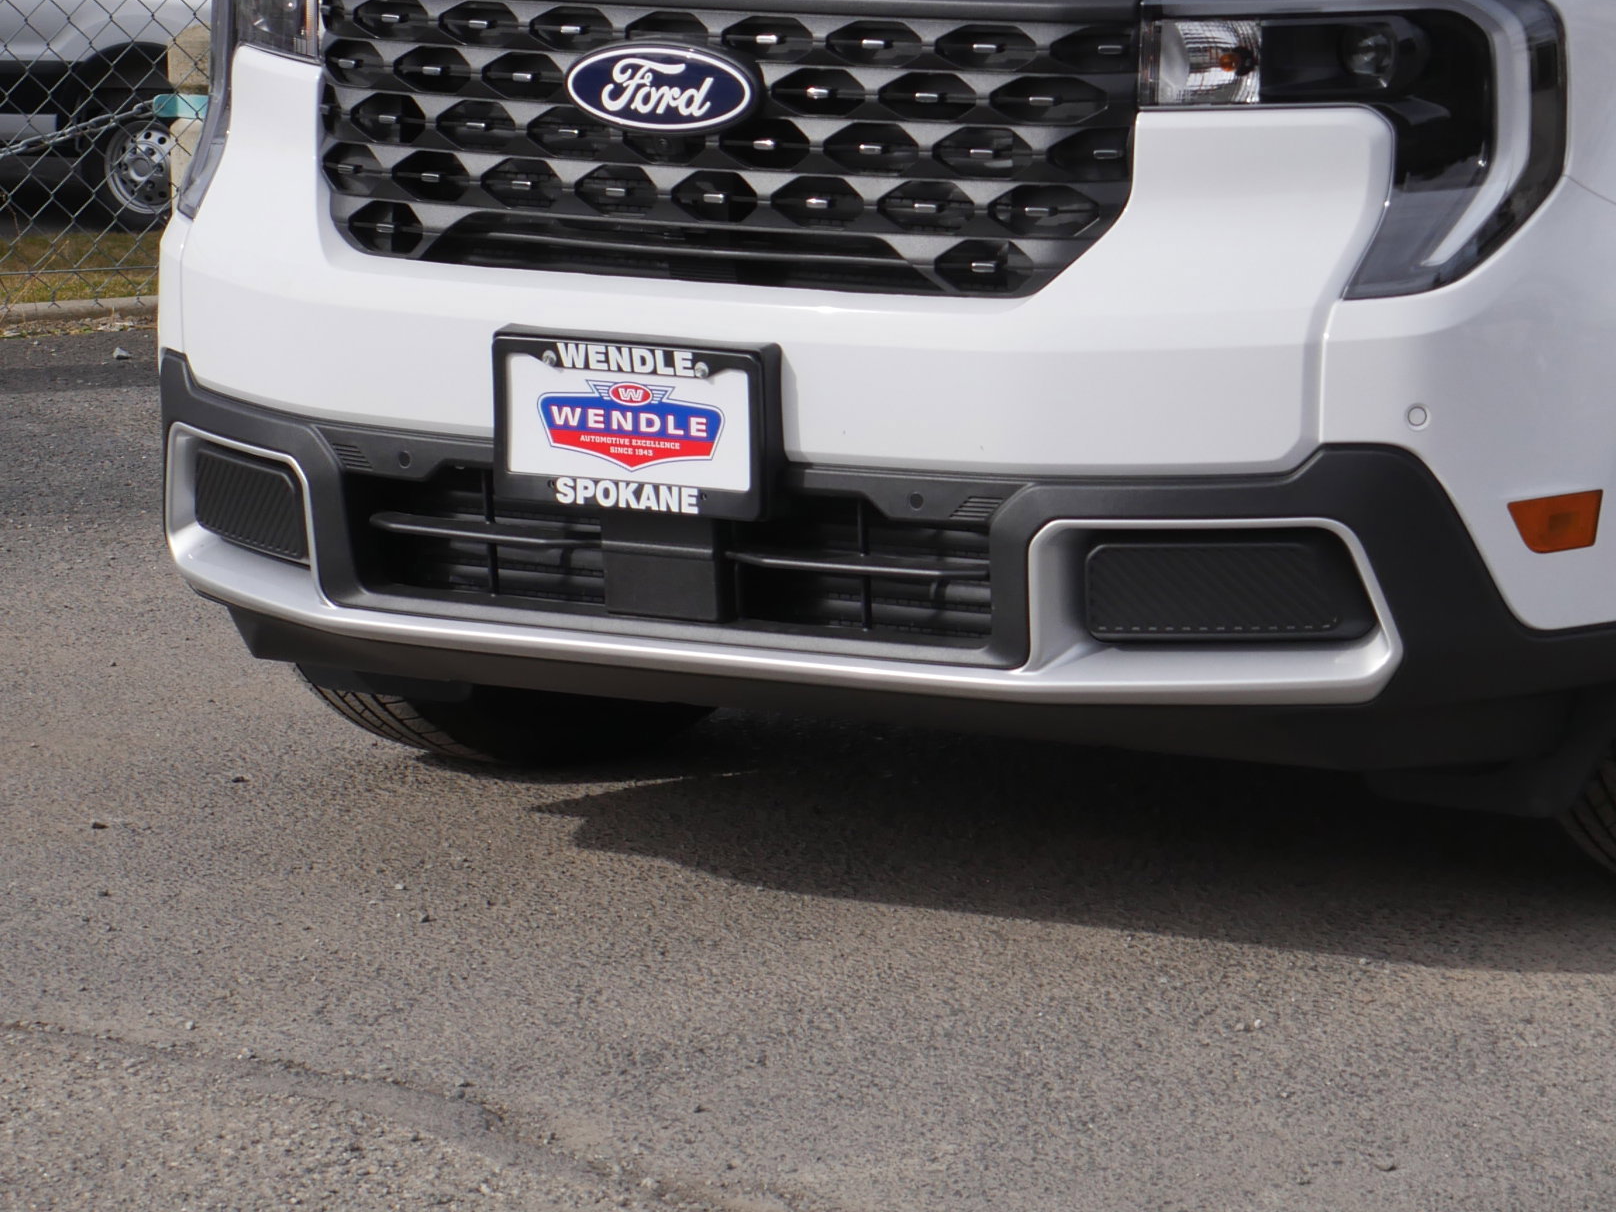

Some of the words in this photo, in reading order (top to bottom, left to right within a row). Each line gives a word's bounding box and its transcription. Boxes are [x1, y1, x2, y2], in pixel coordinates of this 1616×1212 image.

[601, 57, 714, 117] Ford
[556, 342, 695, 377] WENDLE
[550, 404, 708, 438] WENDLE
[580, 434, 630, 445] AUTOMOTIVE
[631, 438, 681, 450] EXCELLENCE
[609, 446, 633, 455] SINCE
[635, 448, 653, 457] 1943
[556, 477, 699, 514] SPOKANE
